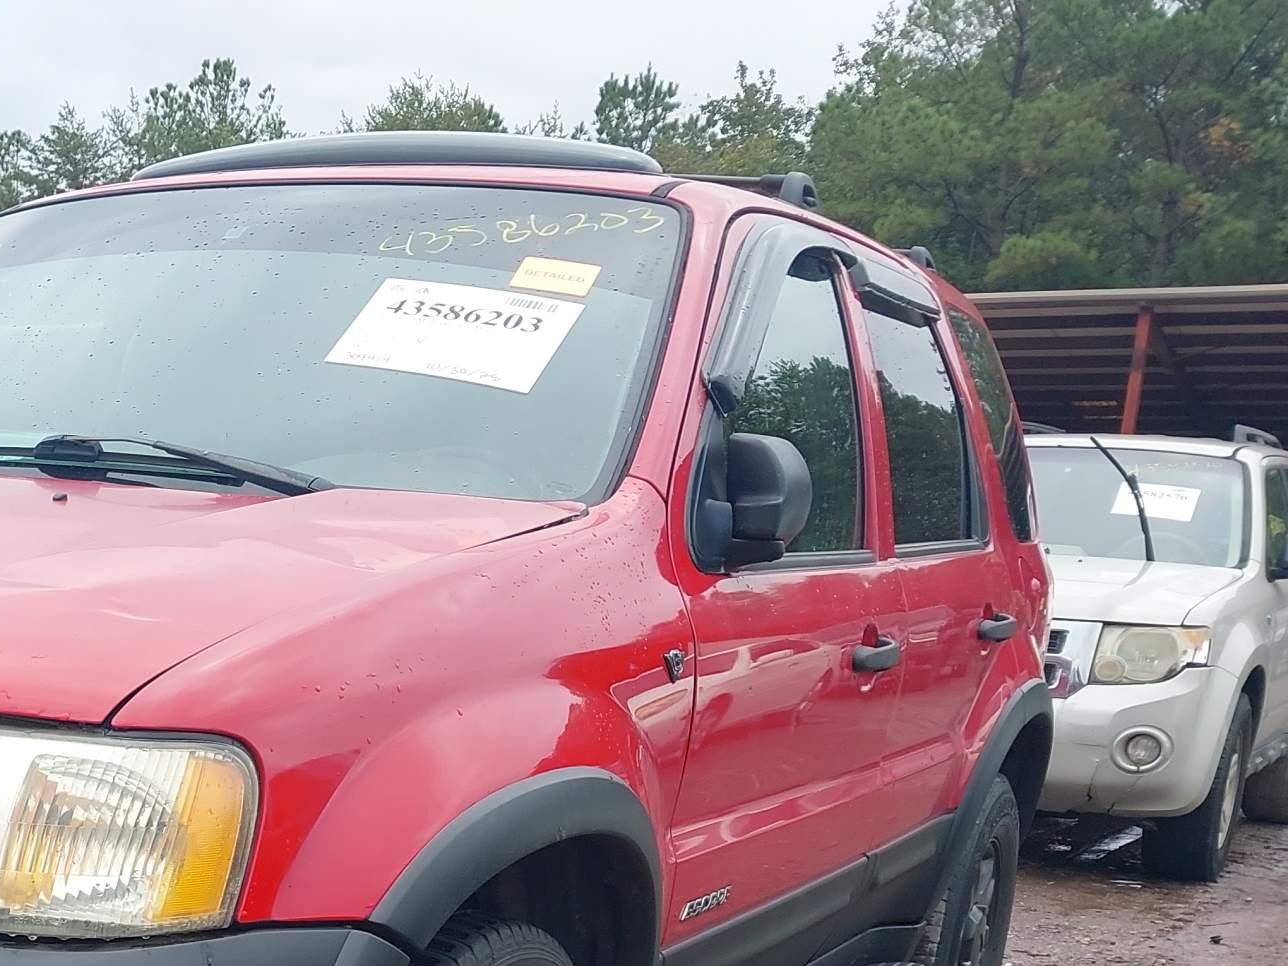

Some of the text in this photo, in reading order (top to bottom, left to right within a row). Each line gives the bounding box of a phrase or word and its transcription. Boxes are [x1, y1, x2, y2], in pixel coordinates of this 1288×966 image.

[378, 207, 665, 256] 43586203
[523, 268, 586, 283] DETAILED
[385, 299, 544, 334] 43586203
